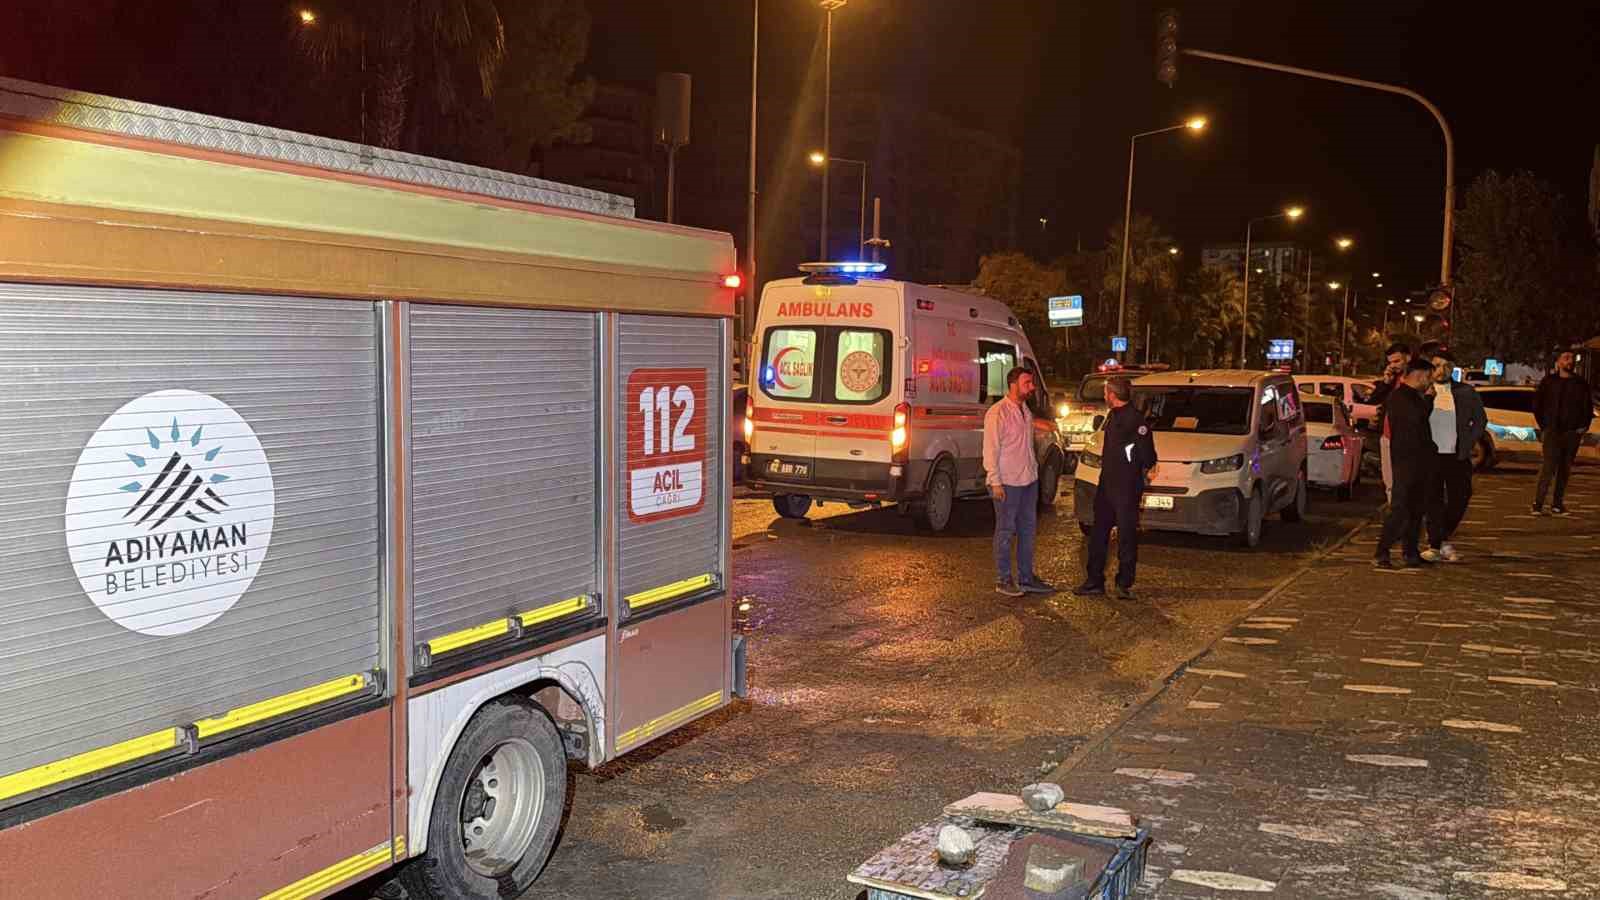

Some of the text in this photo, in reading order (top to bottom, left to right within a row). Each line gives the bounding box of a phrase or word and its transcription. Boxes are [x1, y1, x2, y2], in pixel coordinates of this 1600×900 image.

[777, 302, 873, 318] AMBULANS
[639, 385, 696, 456] 112
[105, 523, 247, 567] ADIYAMAN
